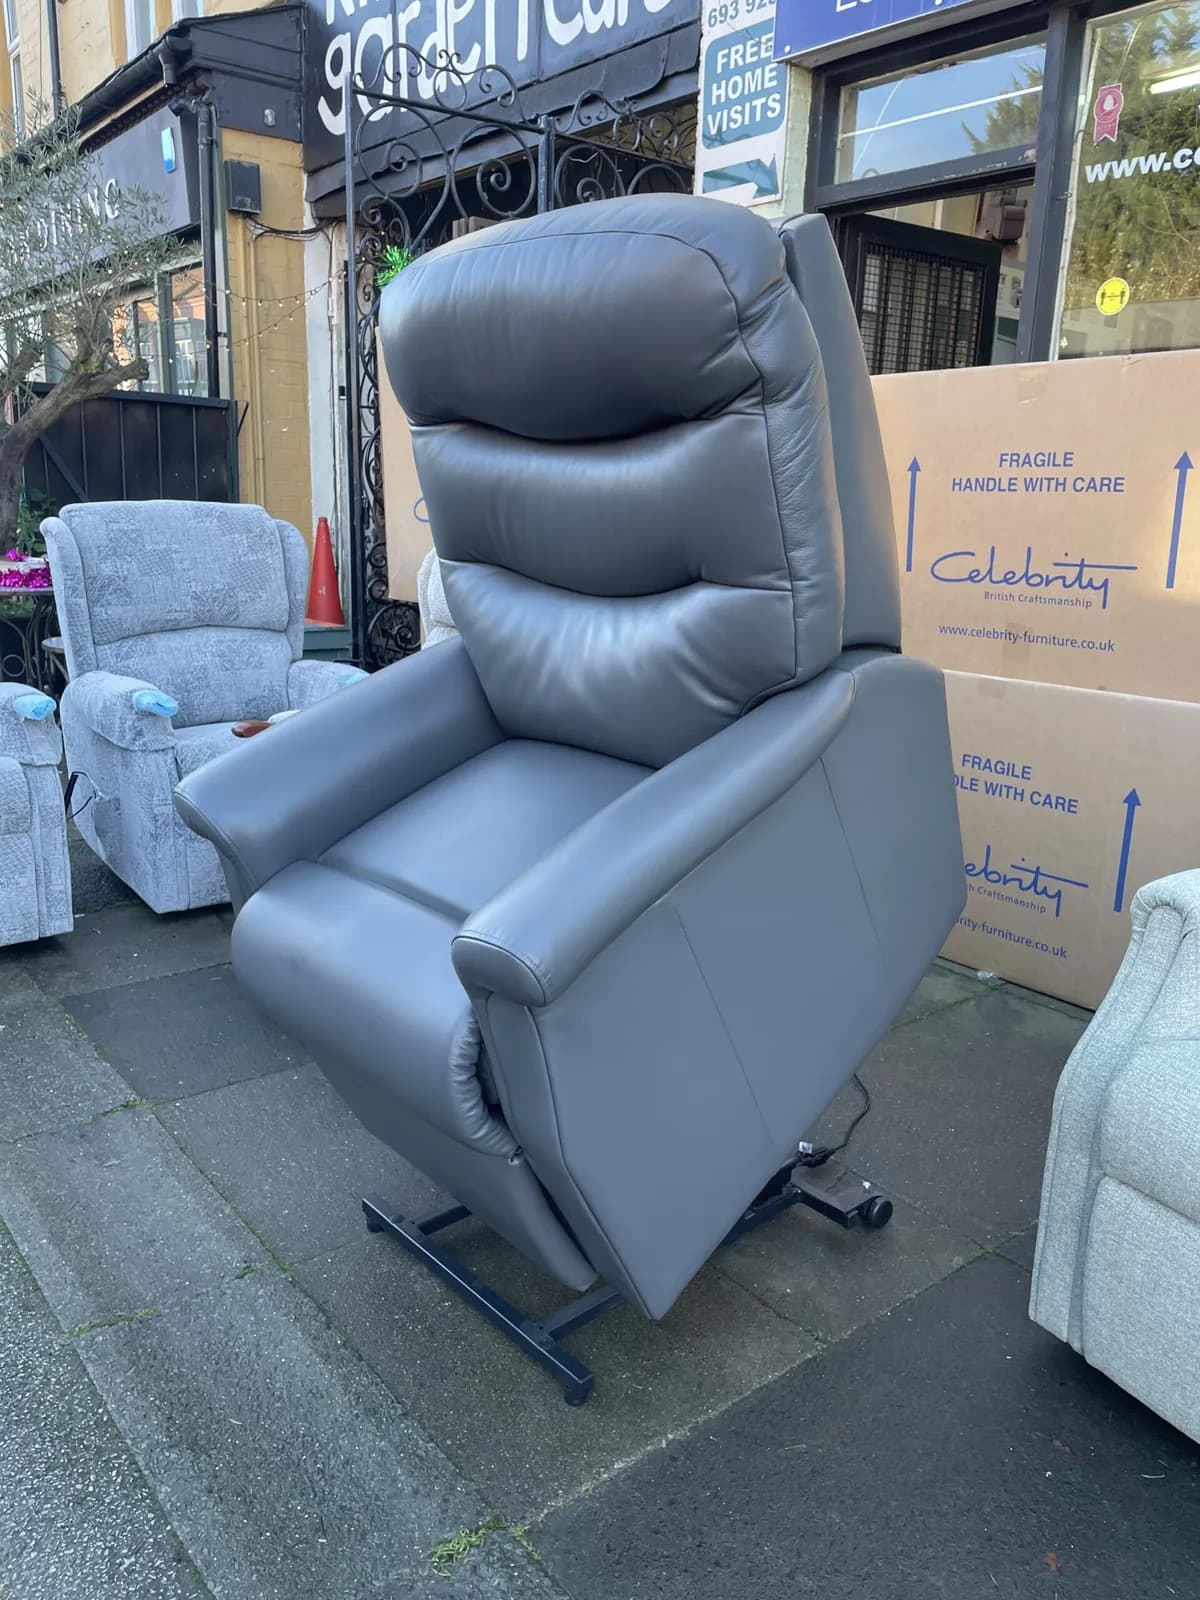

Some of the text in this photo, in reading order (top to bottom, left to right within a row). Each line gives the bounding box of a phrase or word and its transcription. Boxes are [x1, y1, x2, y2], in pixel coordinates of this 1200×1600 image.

[708, 0, 739, 28] 693
[716, 32, 774, 74] FREE
[711, 64, 778, 106] HOME
[707, 93, 781, 136] VISITS
[999, 452, 1075, 468] FRAGILE
[952, 477, 1125, 493] HANDLE WITH CARE
[930, 545, 1138, 609] Celebrity
[984, 591, 1093, 609] British Craftsmanship
[938, 624, 1116, 652] www.celebrity-furniture.co.uk
[961, 753, 1033, 780] FRAGILE
[984, 780, 1025, 802] WITH
[1029, 790, 1080, 814] CARE
[977, 886, 1047, 914] Craftsmanship
[957, 916, 1068, 958] rity-furniture.co.uk
